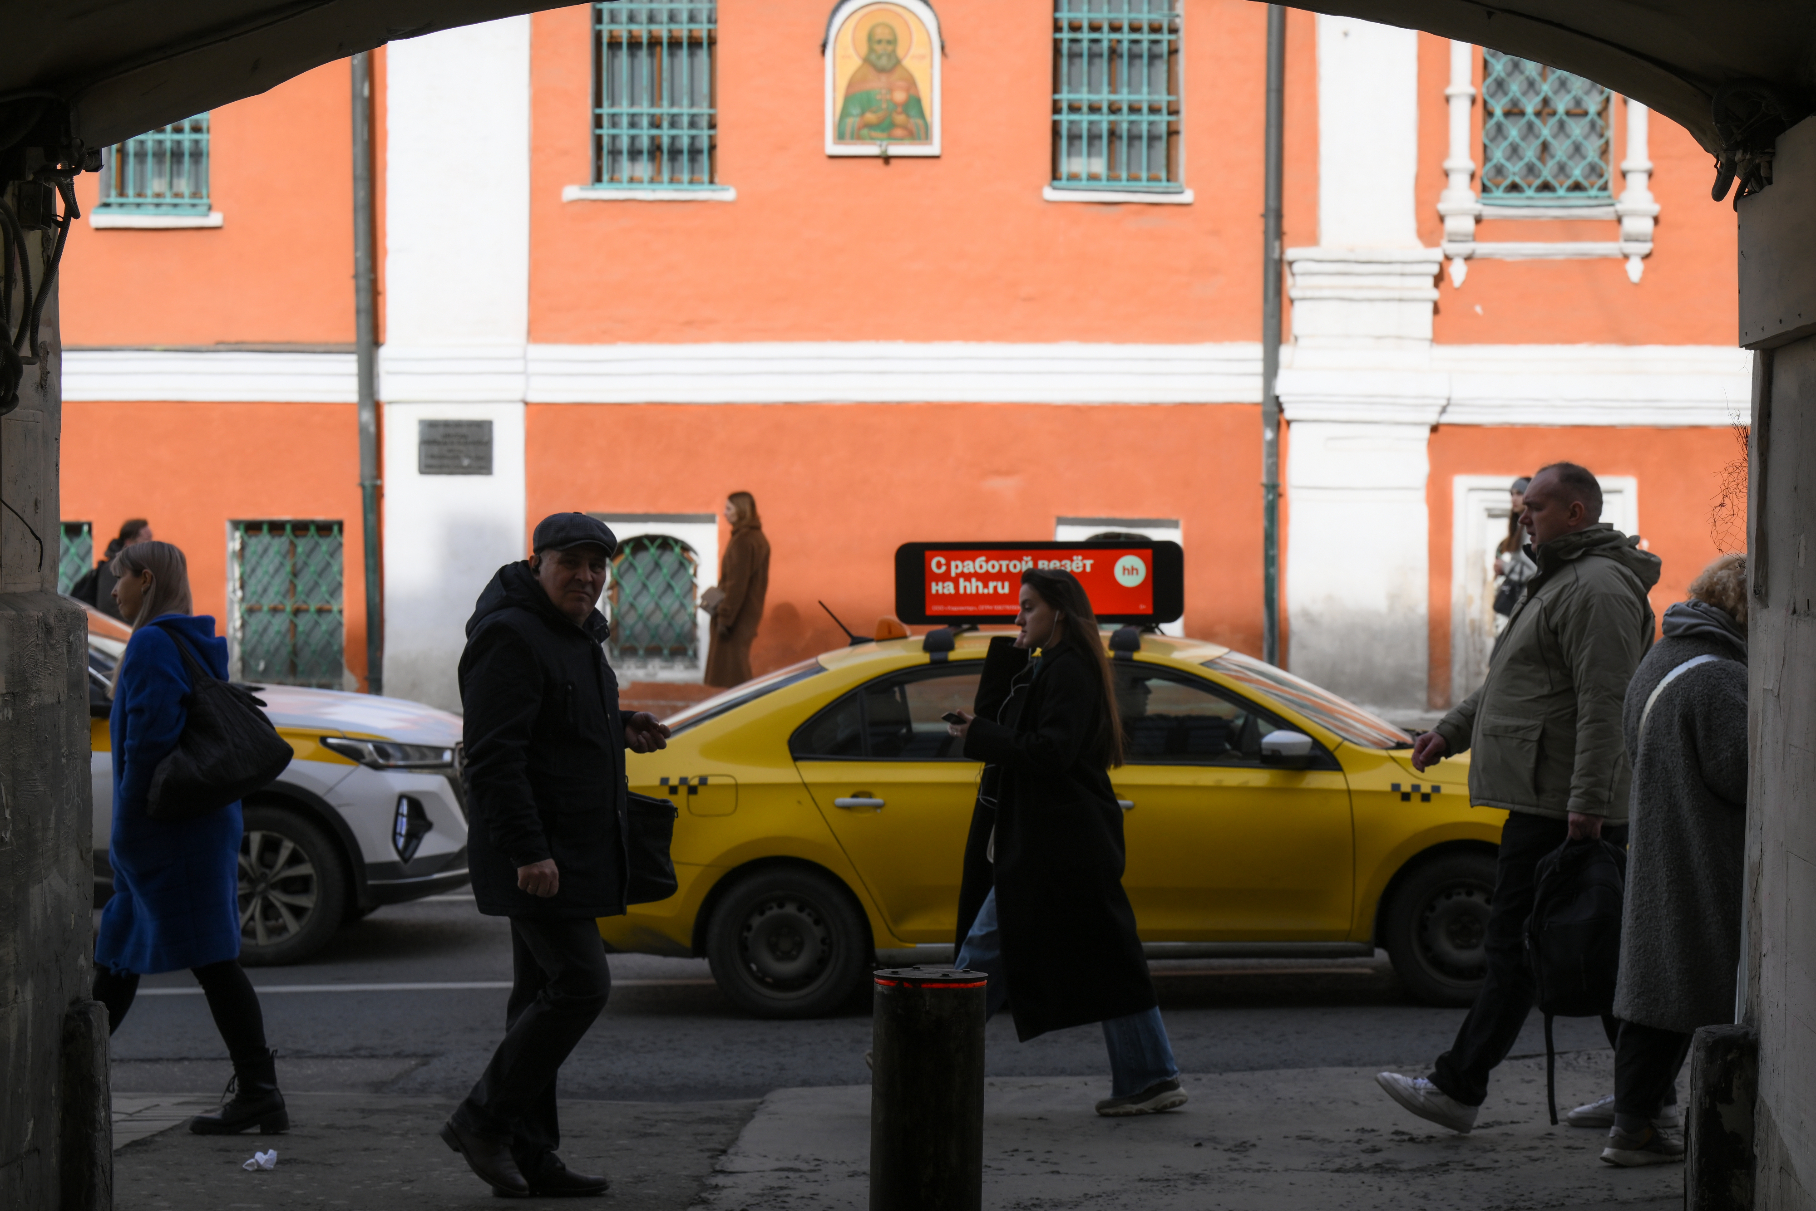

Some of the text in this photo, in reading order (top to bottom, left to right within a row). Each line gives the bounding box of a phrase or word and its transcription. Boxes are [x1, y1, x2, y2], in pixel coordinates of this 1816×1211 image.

[931, 555, 1094, 577] С работой везёт
[1122, 564, 1139, 576] hh
[931, 577, 1009, 594] на hh.ru
